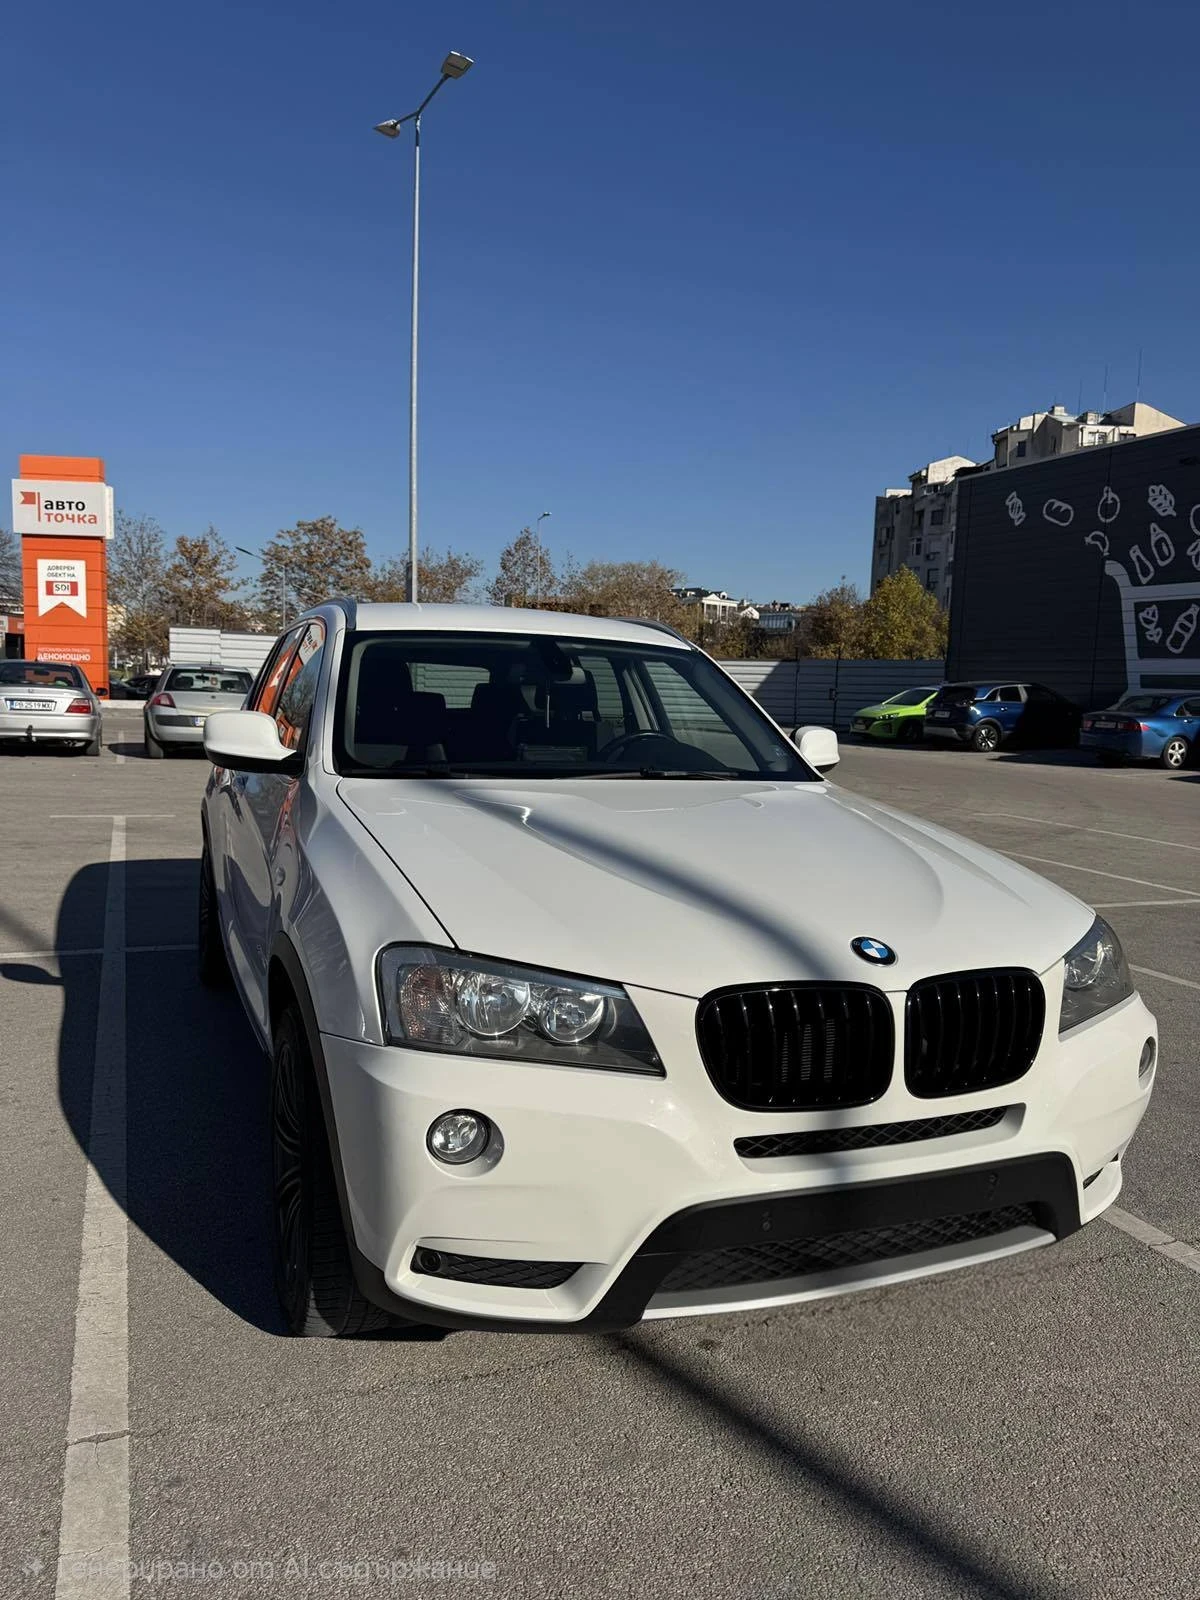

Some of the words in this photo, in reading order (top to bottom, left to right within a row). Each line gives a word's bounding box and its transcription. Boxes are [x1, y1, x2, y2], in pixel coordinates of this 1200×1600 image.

[44, 500, 86, 511] авто
[44, 513, 97, 524] точка
[37, 653, 91, 662] ДЕНОНОЩНО
